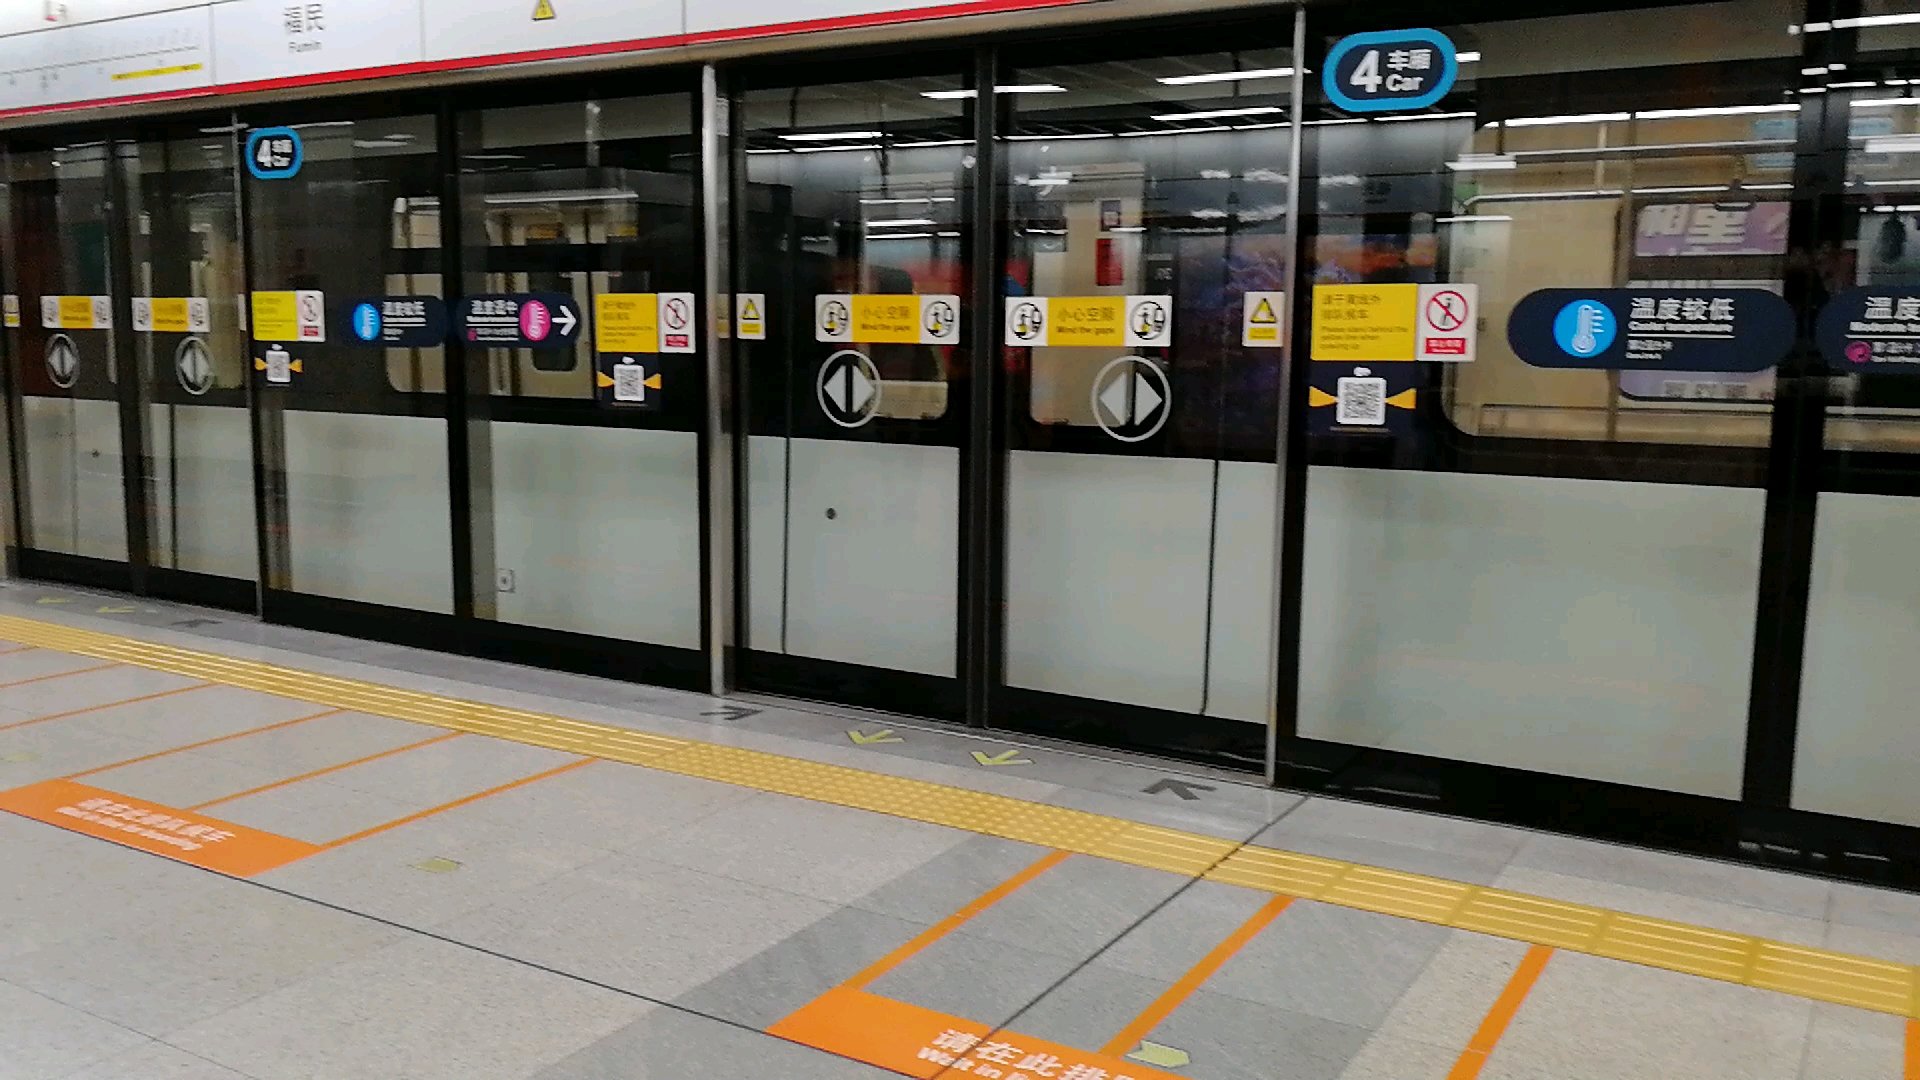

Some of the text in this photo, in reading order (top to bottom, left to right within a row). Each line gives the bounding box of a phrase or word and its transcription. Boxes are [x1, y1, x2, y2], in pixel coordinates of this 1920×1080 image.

[1350, 50, 1382, 92] 4
[1386, 73, 1424, 91] Car
[257, 140, 271, 167] 4
[1630, 298, 1735, 320] 温度较低
[917, 1047, 975, 1071] Wait
